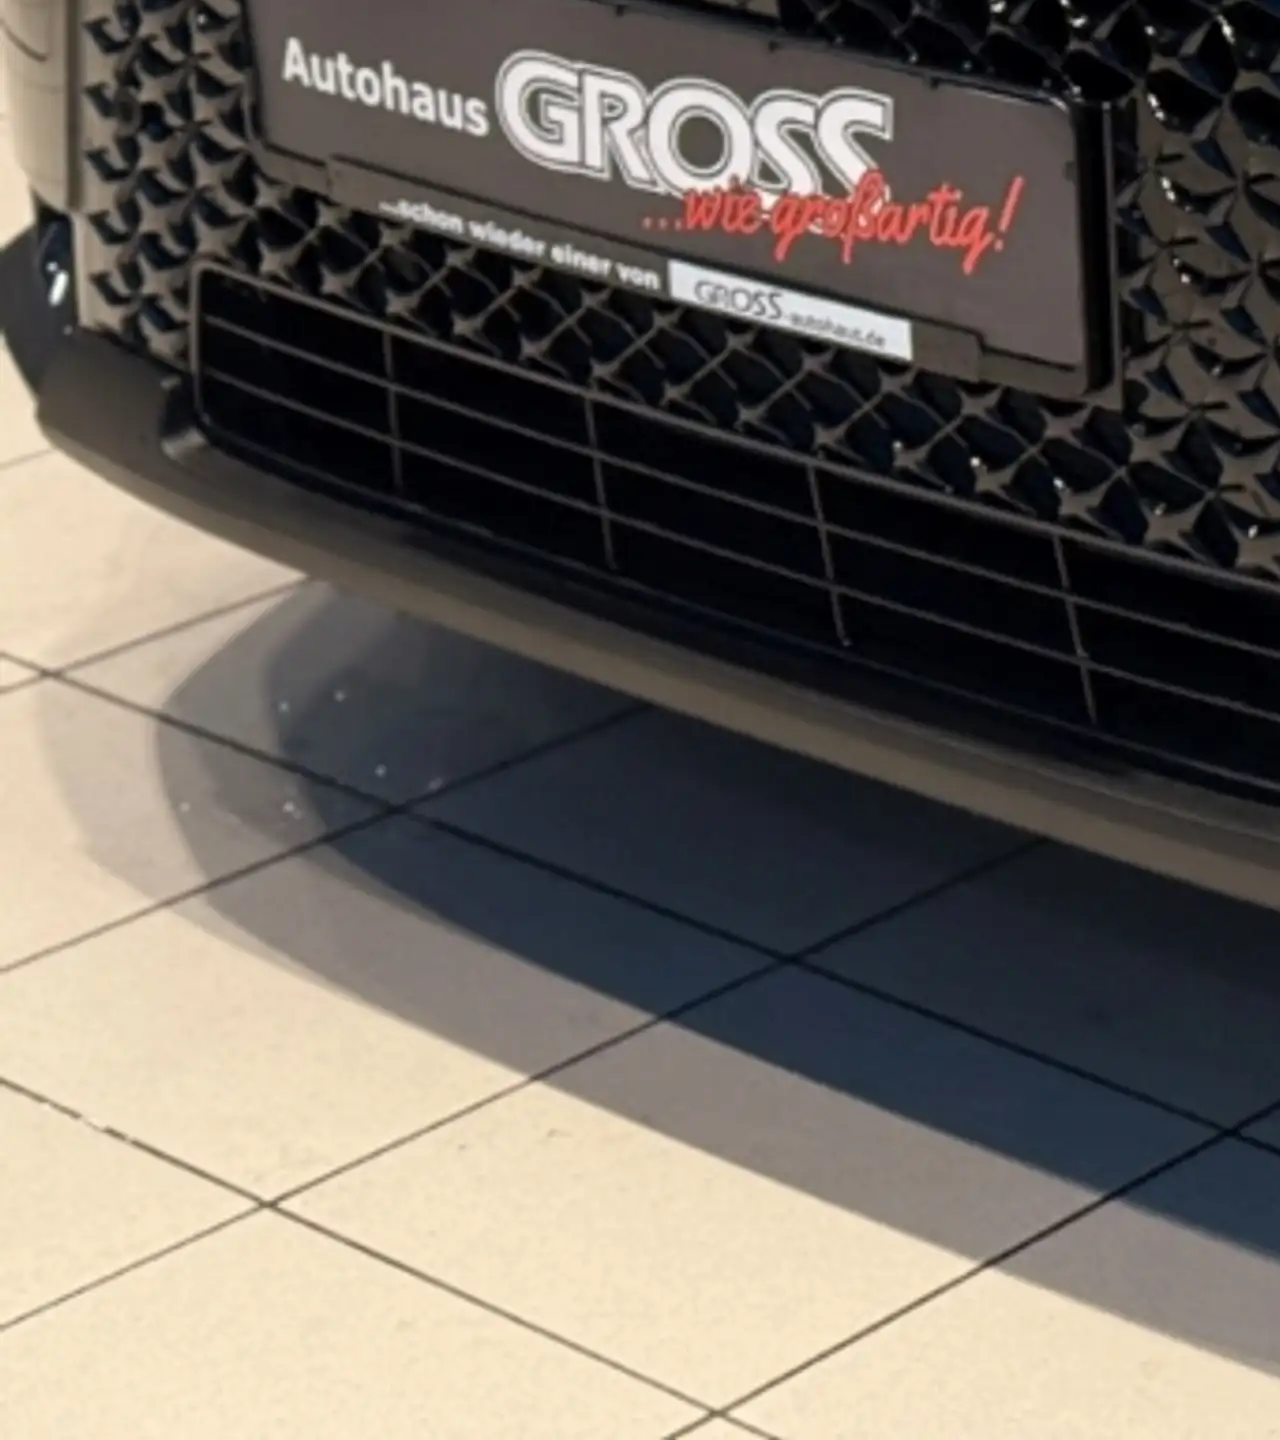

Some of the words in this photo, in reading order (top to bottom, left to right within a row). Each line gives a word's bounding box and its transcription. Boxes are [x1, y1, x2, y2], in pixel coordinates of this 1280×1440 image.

[282, 36, 490, 137] Autohaus
[494, 49, 893, 222] GROSS
[468, 220, 546, 257] wieder
[551, 243, 613, 276] einer
[616, 262, 661, 291] von
[771, 167, 1025, 276] großartig!
